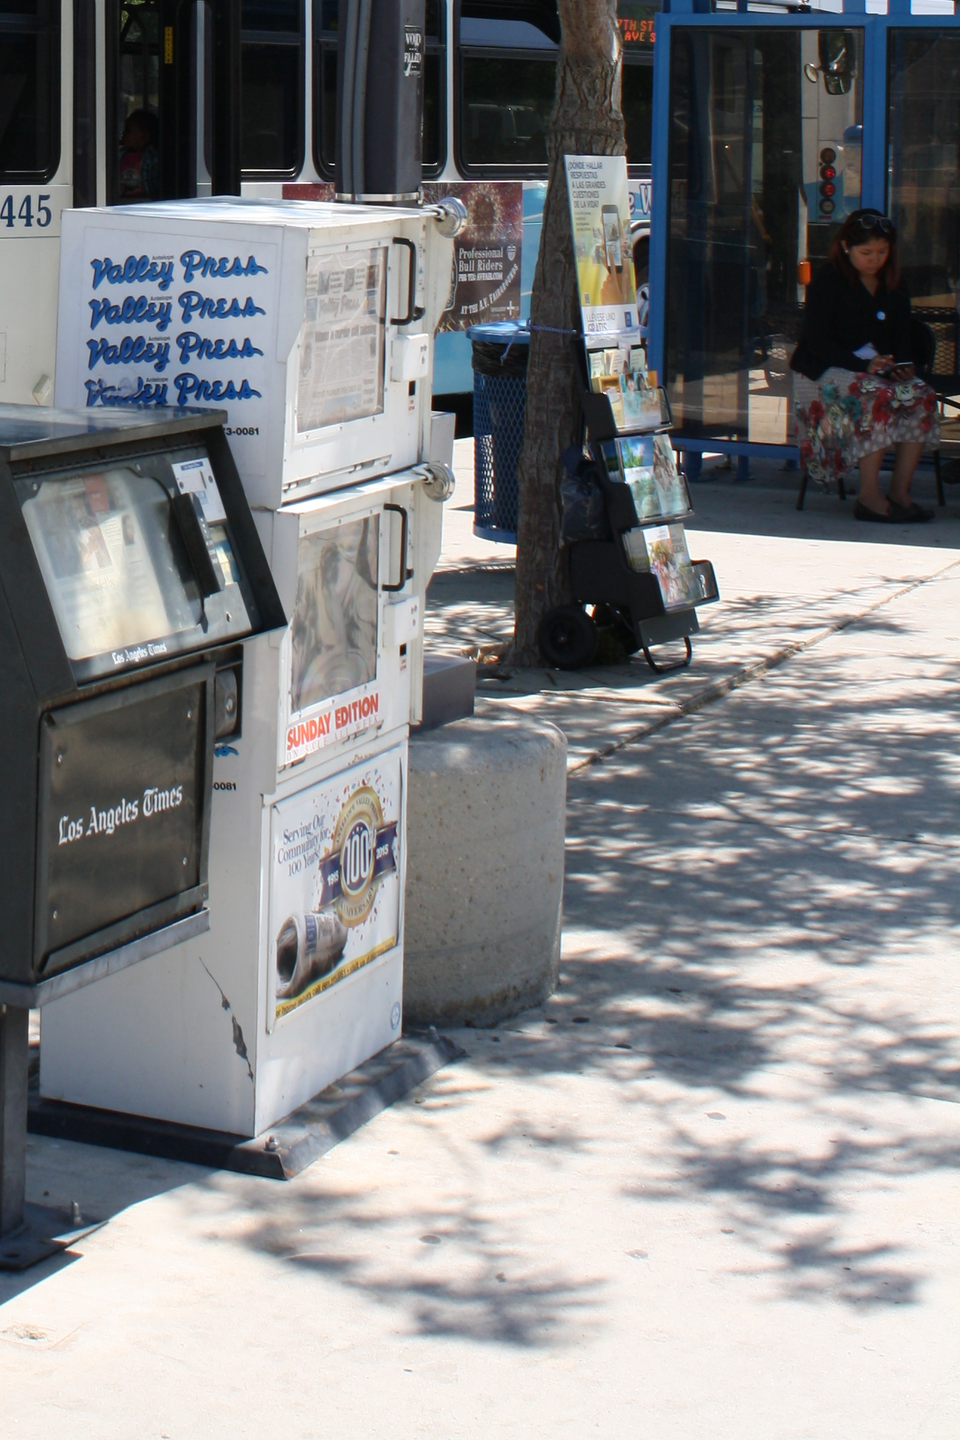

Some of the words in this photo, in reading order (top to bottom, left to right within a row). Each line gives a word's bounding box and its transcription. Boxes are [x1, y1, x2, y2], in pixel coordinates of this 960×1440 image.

[624, 32, 645, 42] AVE
[458, 247, 504, 259] Professional
[459, 260, 476, 271] Bull
[477, 260, 503, 272] Riders
[90, 255, 174, 291] Valley
[180, 249, 269, 283] Press
[88, 295, 172, 332] Valley
[178, 290, 266, 324] Press
[86, 335, 170, 372] Valley
[176, 331, 264, 365] Press
[173, 372, 262, 406] Press
[223, 427, 259, 436] 3-0081
[111, 652, 125, 664] Los
[147, 643, 167, 656] Times
[287, 711, 331, 751] SUNDAY
[334, 692, 379, 730] EDITION
[58, 815, 84, 846] Los
[85, 797, 139, 836] Angeles
[142, 785, 183, 817] Times
[277, 834, 319, 865] Community
[283, 822, 313, 846] Serving
[288, 859, 302, 877] 100
[343, 829, 369, 885] 100
